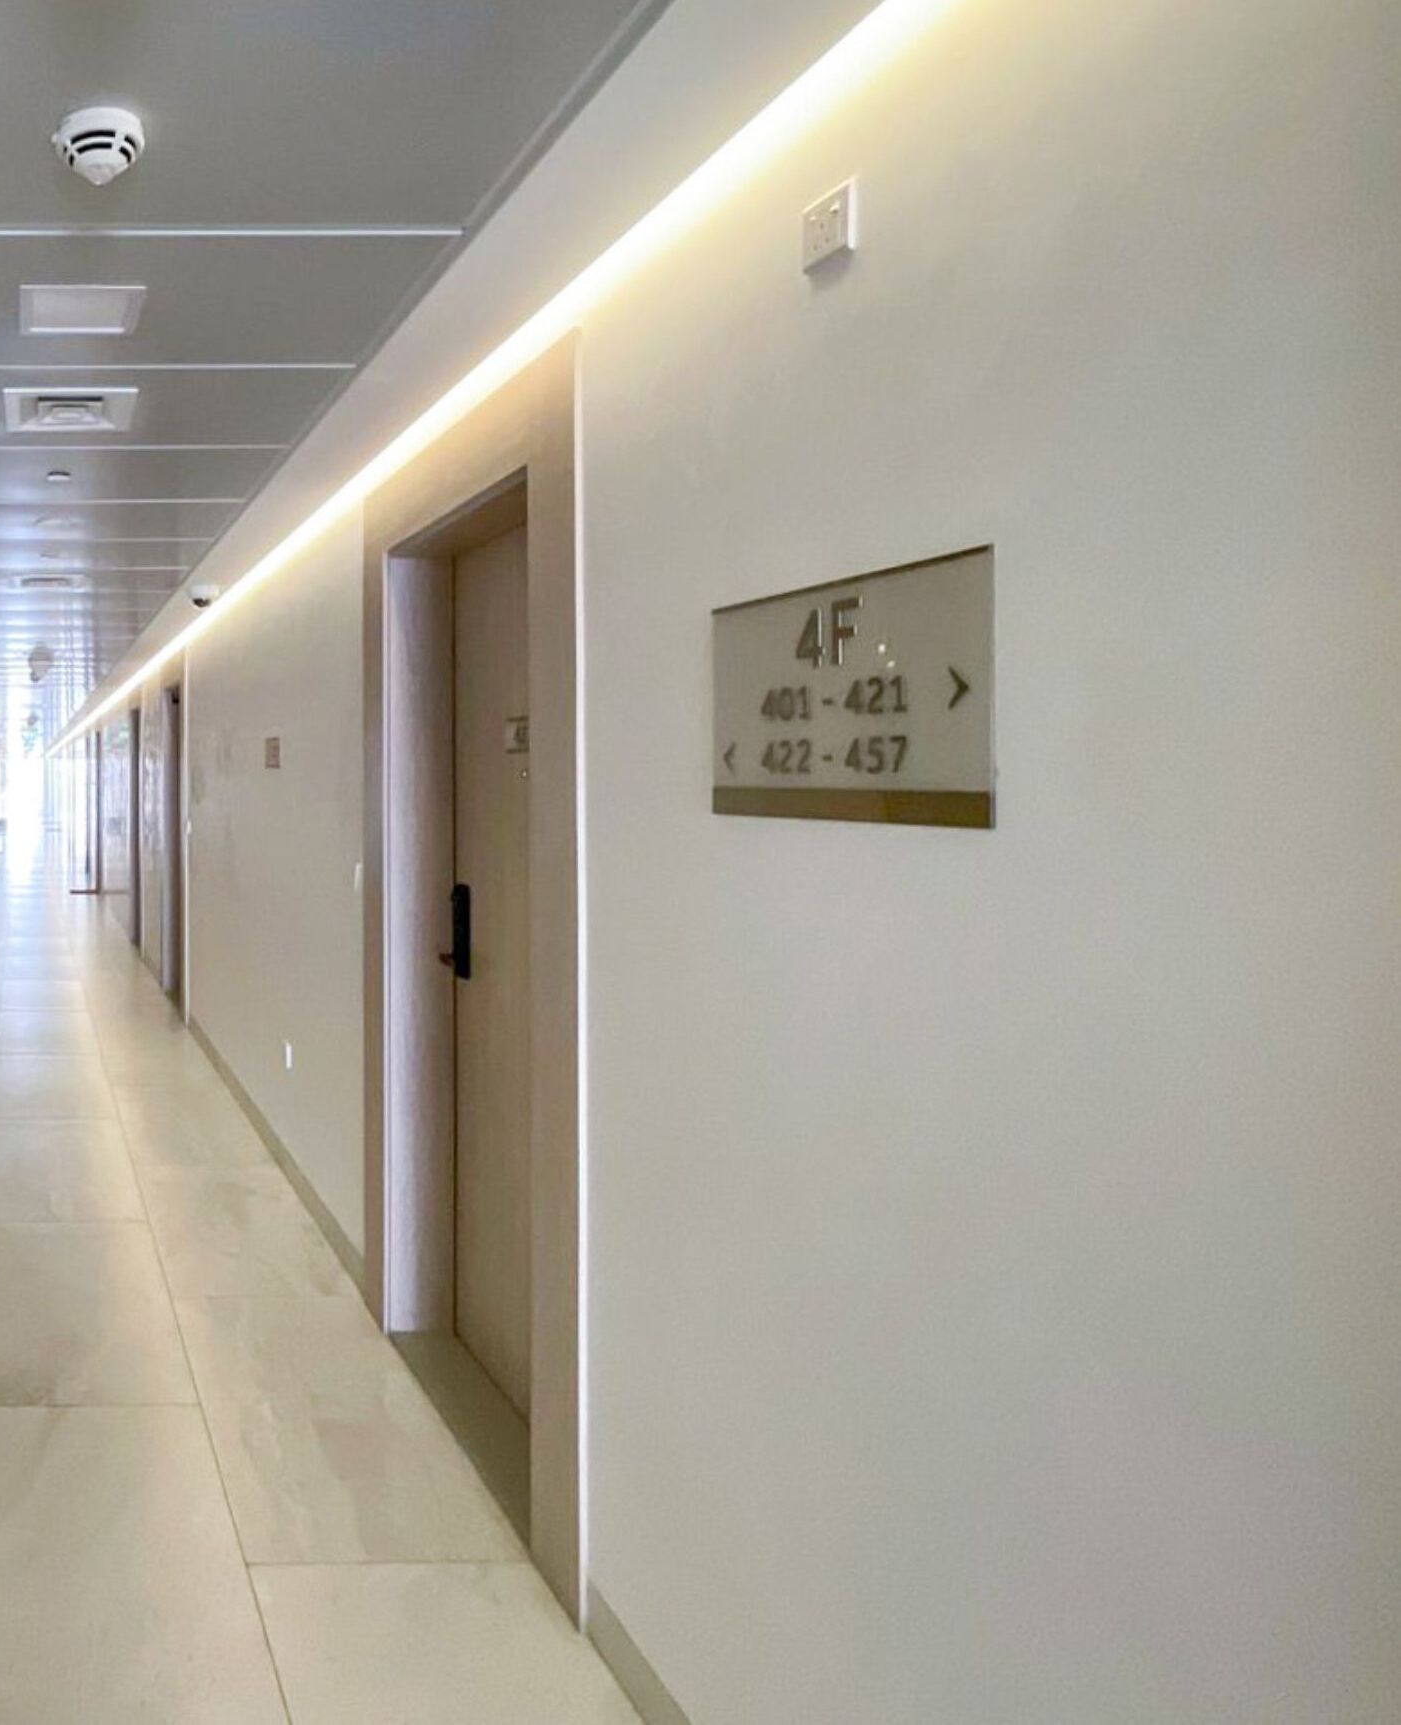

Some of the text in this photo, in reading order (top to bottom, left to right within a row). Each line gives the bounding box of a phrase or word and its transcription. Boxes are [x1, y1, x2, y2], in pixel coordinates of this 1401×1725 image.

[796, 597, 862, 669] 4F
[761, 685, 812, 720] 401
[844, 674, 907, 715] 421
[761, 738, 811, 774] 422
[844, 735, 909, 774] 457
